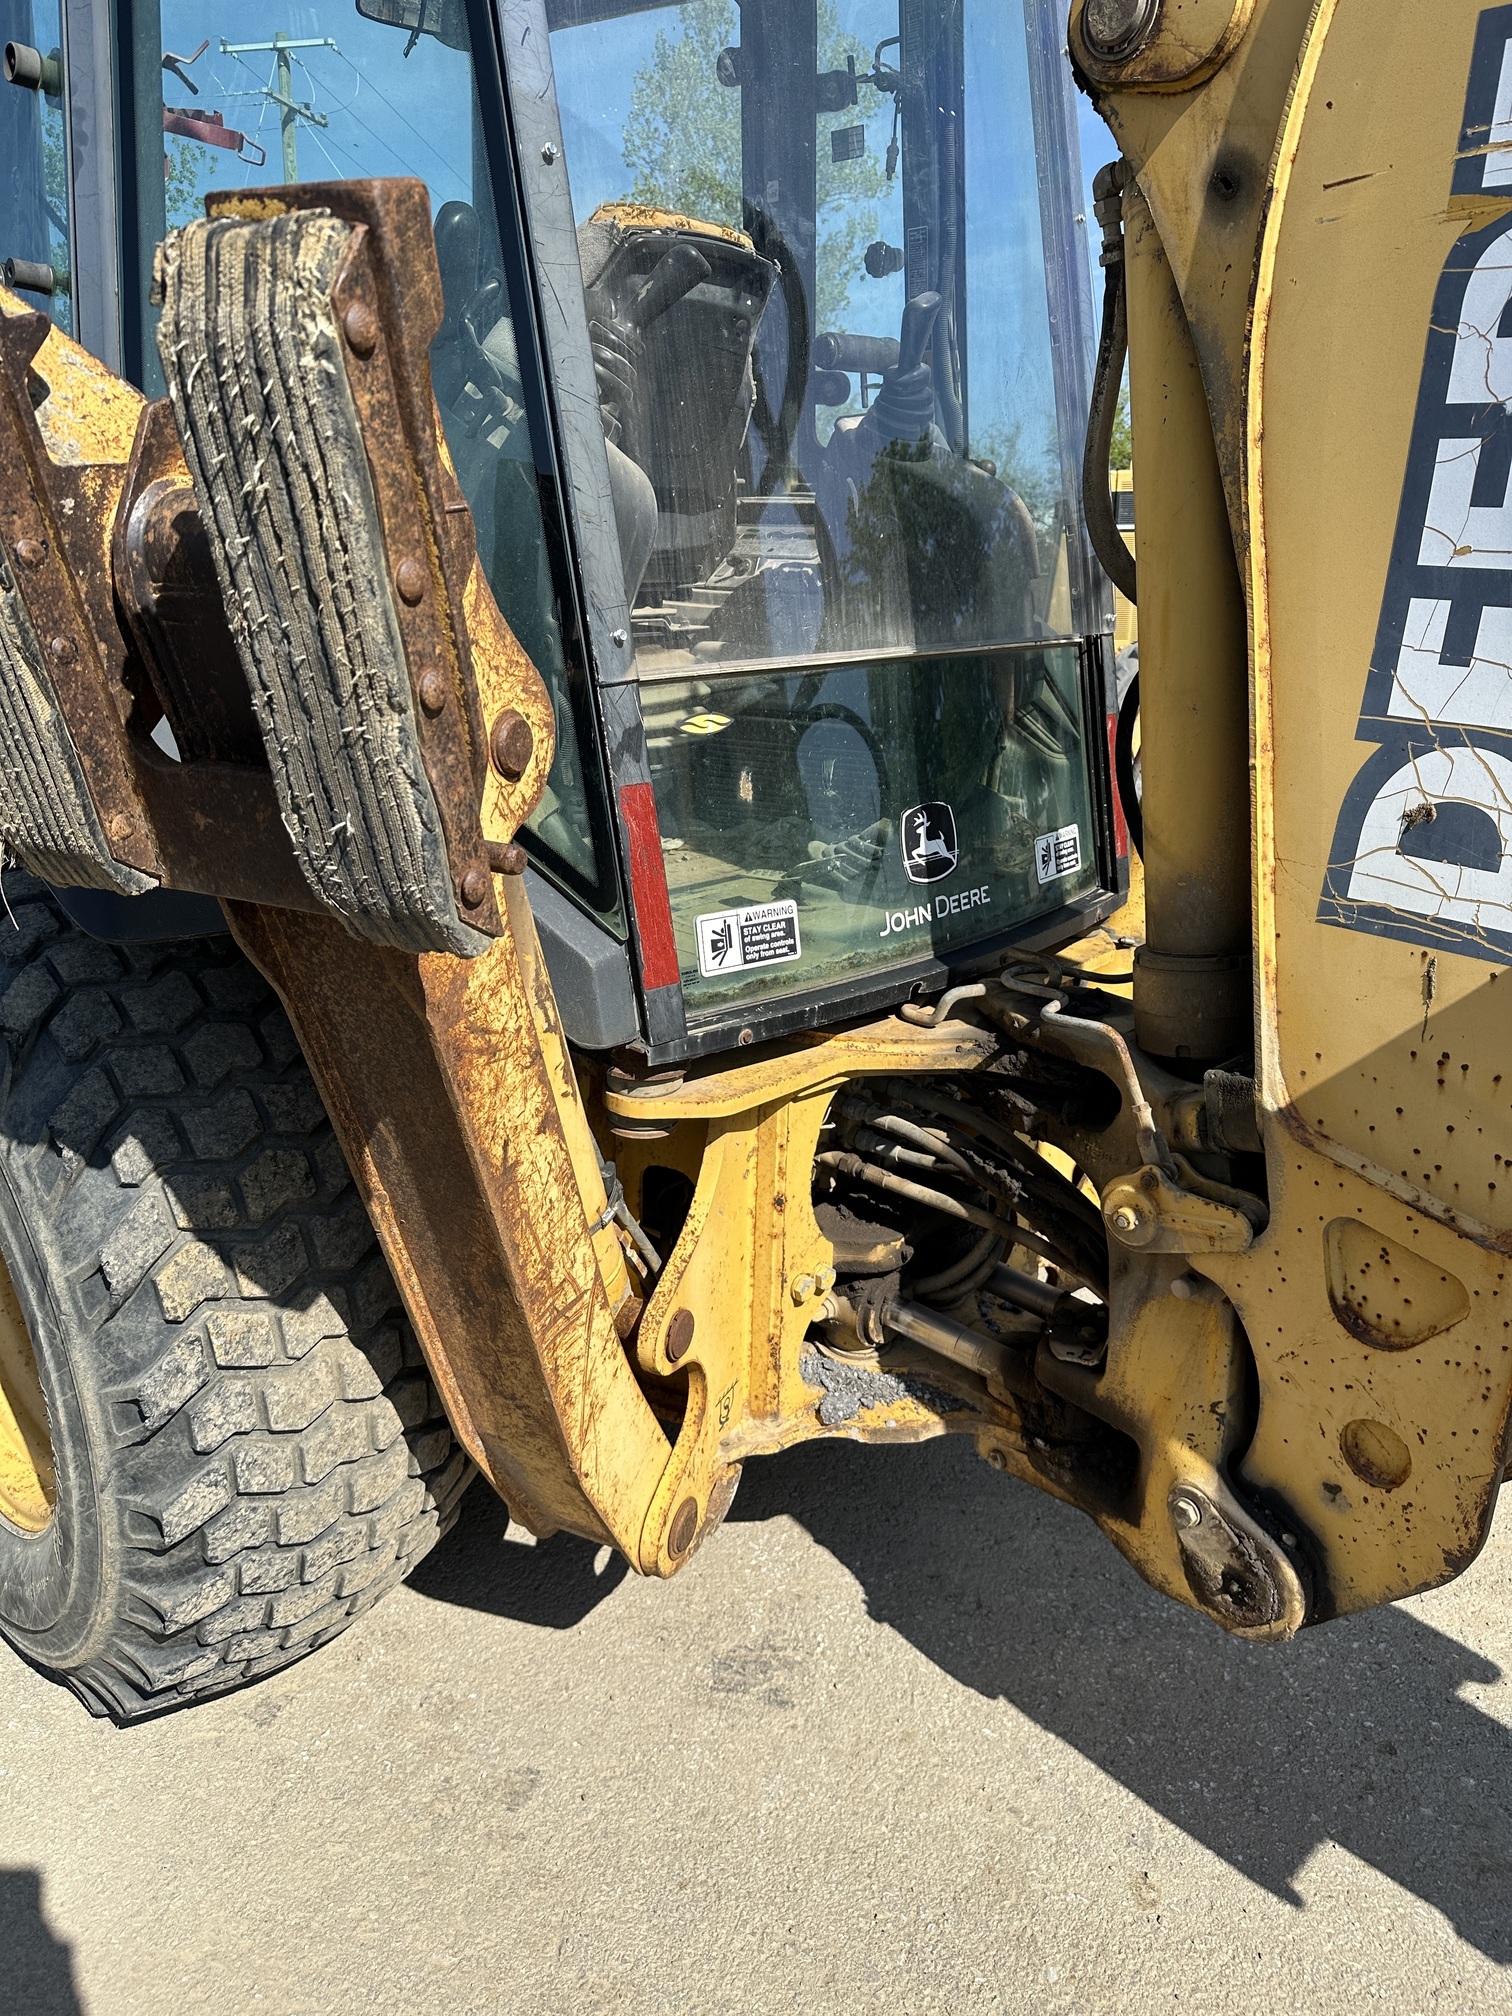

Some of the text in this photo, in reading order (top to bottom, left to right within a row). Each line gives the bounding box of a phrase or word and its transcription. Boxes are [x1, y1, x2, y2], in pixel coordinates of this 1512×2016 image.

[752, 905, 794, 920] WARNING
[880, 885, 991, 937] JOHN DEERE
[743, 921, 786, 935] STAY CLEAR
[744, 935, 751, 943] of
[745, 938, 794, 953] Operate controls
[746, 951, 760, 960] only
